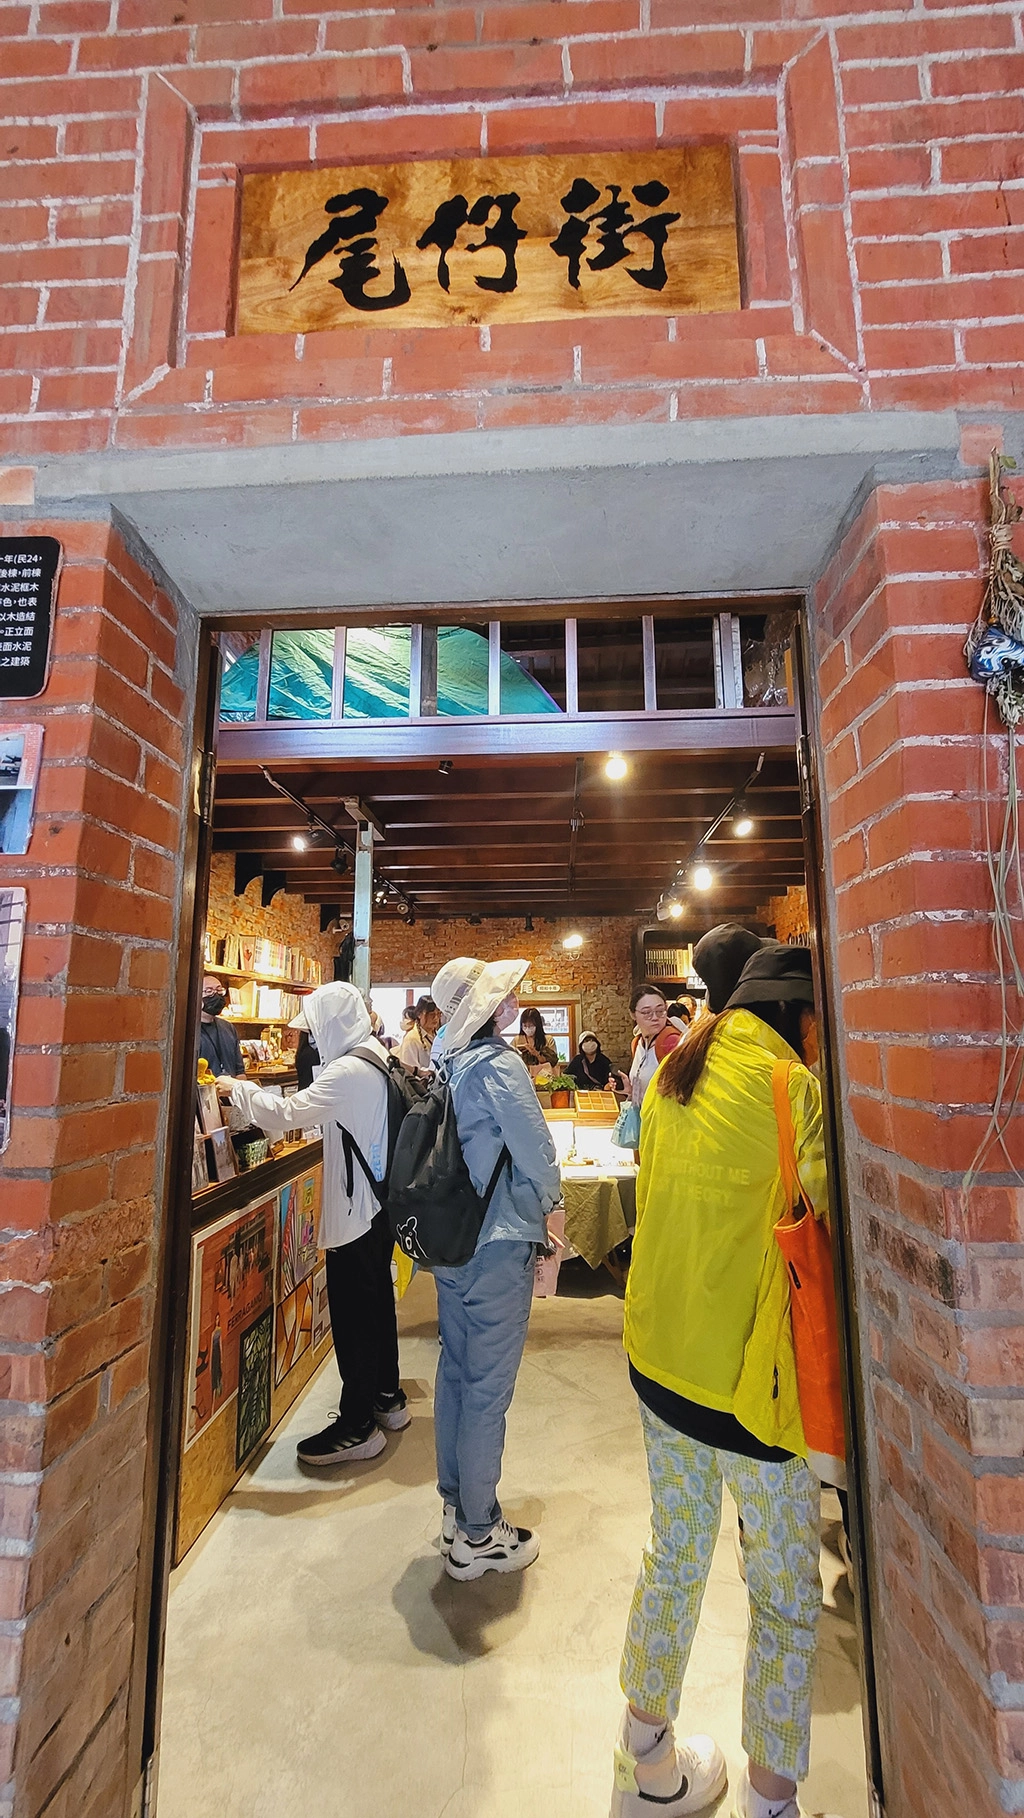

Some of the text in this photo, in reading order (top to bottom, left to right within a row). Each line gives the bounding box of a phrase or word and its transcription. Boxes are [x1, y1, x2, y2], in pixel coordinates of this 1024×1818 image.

[0, 597, 37, 607] 色，也表
[0, 641, 32, 651] 面水泥
[520, 980, 533, 994] 尾
